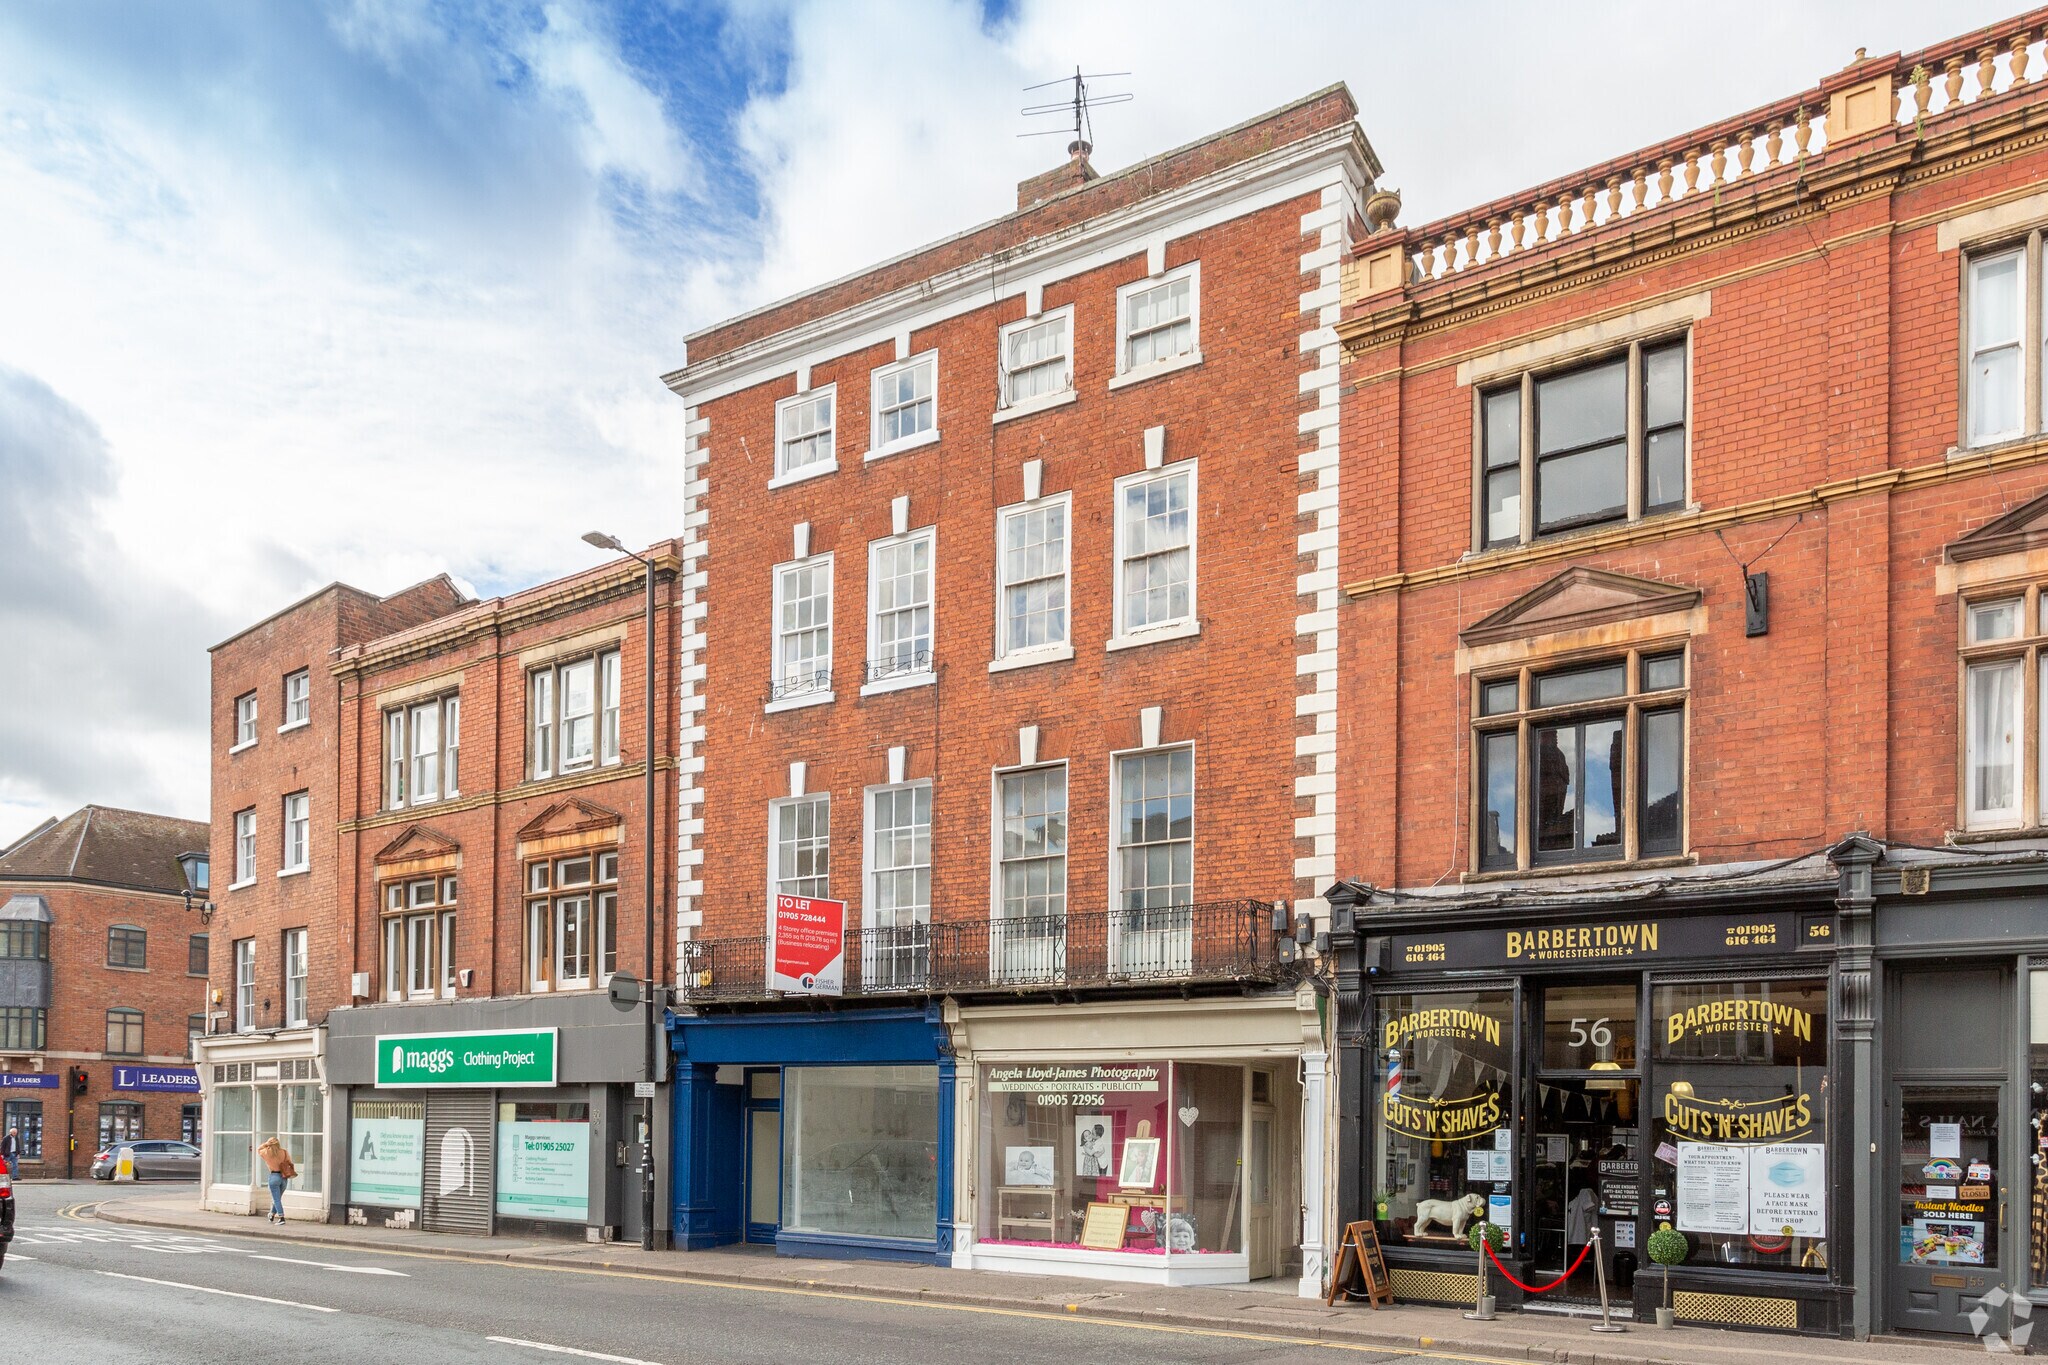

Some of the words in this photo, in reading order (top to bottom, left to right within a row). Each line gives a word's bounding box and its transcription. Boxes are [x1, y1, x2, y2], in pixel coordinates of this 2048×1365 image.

[779, 897, 793, 908] TO
[796, 899, 810, 910] LET
[779, 912, 798, 920] 01905
[800, 914, 826, 923] 728444
[1736, 924, 1776, 934] 01905
[1809, 925, 1830, 937] 56
[1507, 923, 1658, 958] BARBERTOWN
[1726, 935, 1748, 945] 616
[1751, 934, 1776, 944] 464
[1414, 944, 1445, 953] 01905
[1538, 947, 1623, 960] WORCESTERSHIRE
[1406, 953, 1424, 962] 616
[1426, 952, 1446, 961] 464
[1668, 1000, 1810, 1044] BARBERTOWN
[1706, 1022, 1768, 1033] WORCESTER
[1386, 1008, 1500, 1049] BARBERTOWN
[1416, 1028, 1466, 1039] WORCESTER
[1568, 1018, 1612, 1047] 56
[407, 1049, 454, 1073] maggs
[464, 1051, 501, 1068] Clothing
[502, 1050, 534, 1068] Project
[119, 1070, 134, 1086] L
[142, 1074, 198, 1084] LEADERS
[989, 1068, 1022, 1081] Angela
[1026, 1067, 1087, 1081] Lloyd-James
[1090, 1066, 1159, 1080] Photography
[1038, 1095, 1068, 1106] 01905
[1072, 1094, 1105, 1106] 22956
[1384, 1092, 1421, 1130] CUTS
[1442, 1093, 1500, 1133] SHAVES
[1665, 1093, 1712, 1136] CUTS
[1738, 1093, 1810, 1139] SHAVES
[525, 1142, 535, 1150] Tel:
[536, 1142, 554, 1151] 01905
[555, 1143, 575, 1151] 25027
[1914, 1200, 1946, 1210] Instant
[1948, 1202, 1984, 1212] Noodles
[1969, 1275, 1985, 1287] 55
